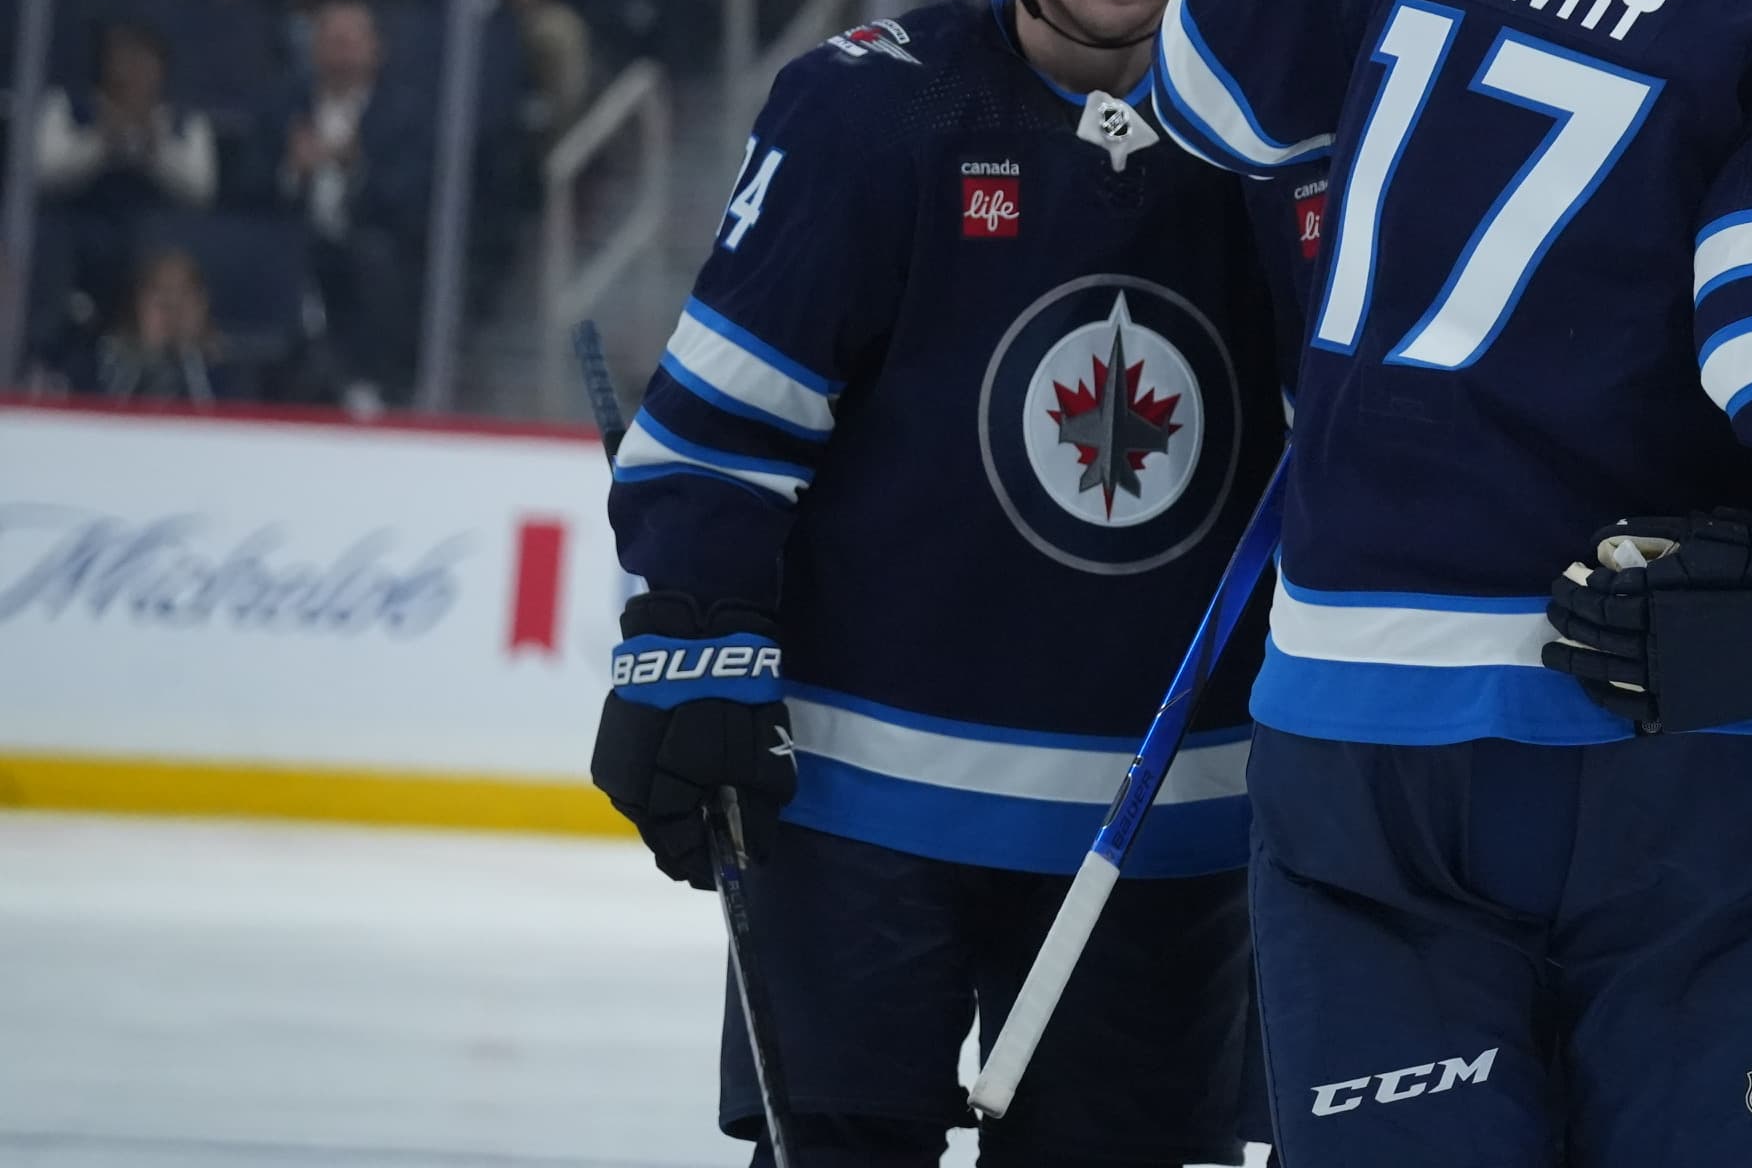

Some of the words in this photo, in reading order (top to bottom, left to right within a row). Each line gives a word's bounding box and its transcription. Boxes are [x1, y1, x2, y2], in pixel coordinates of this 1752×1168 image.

[960, 158, 1020, 177] canada
[1293, 179, 1329, 200] cana
[962, 190, 1021, 232] life
[1300, 211, 1320, 241] li
[1310, 1046, 1499, 1117] CCM
